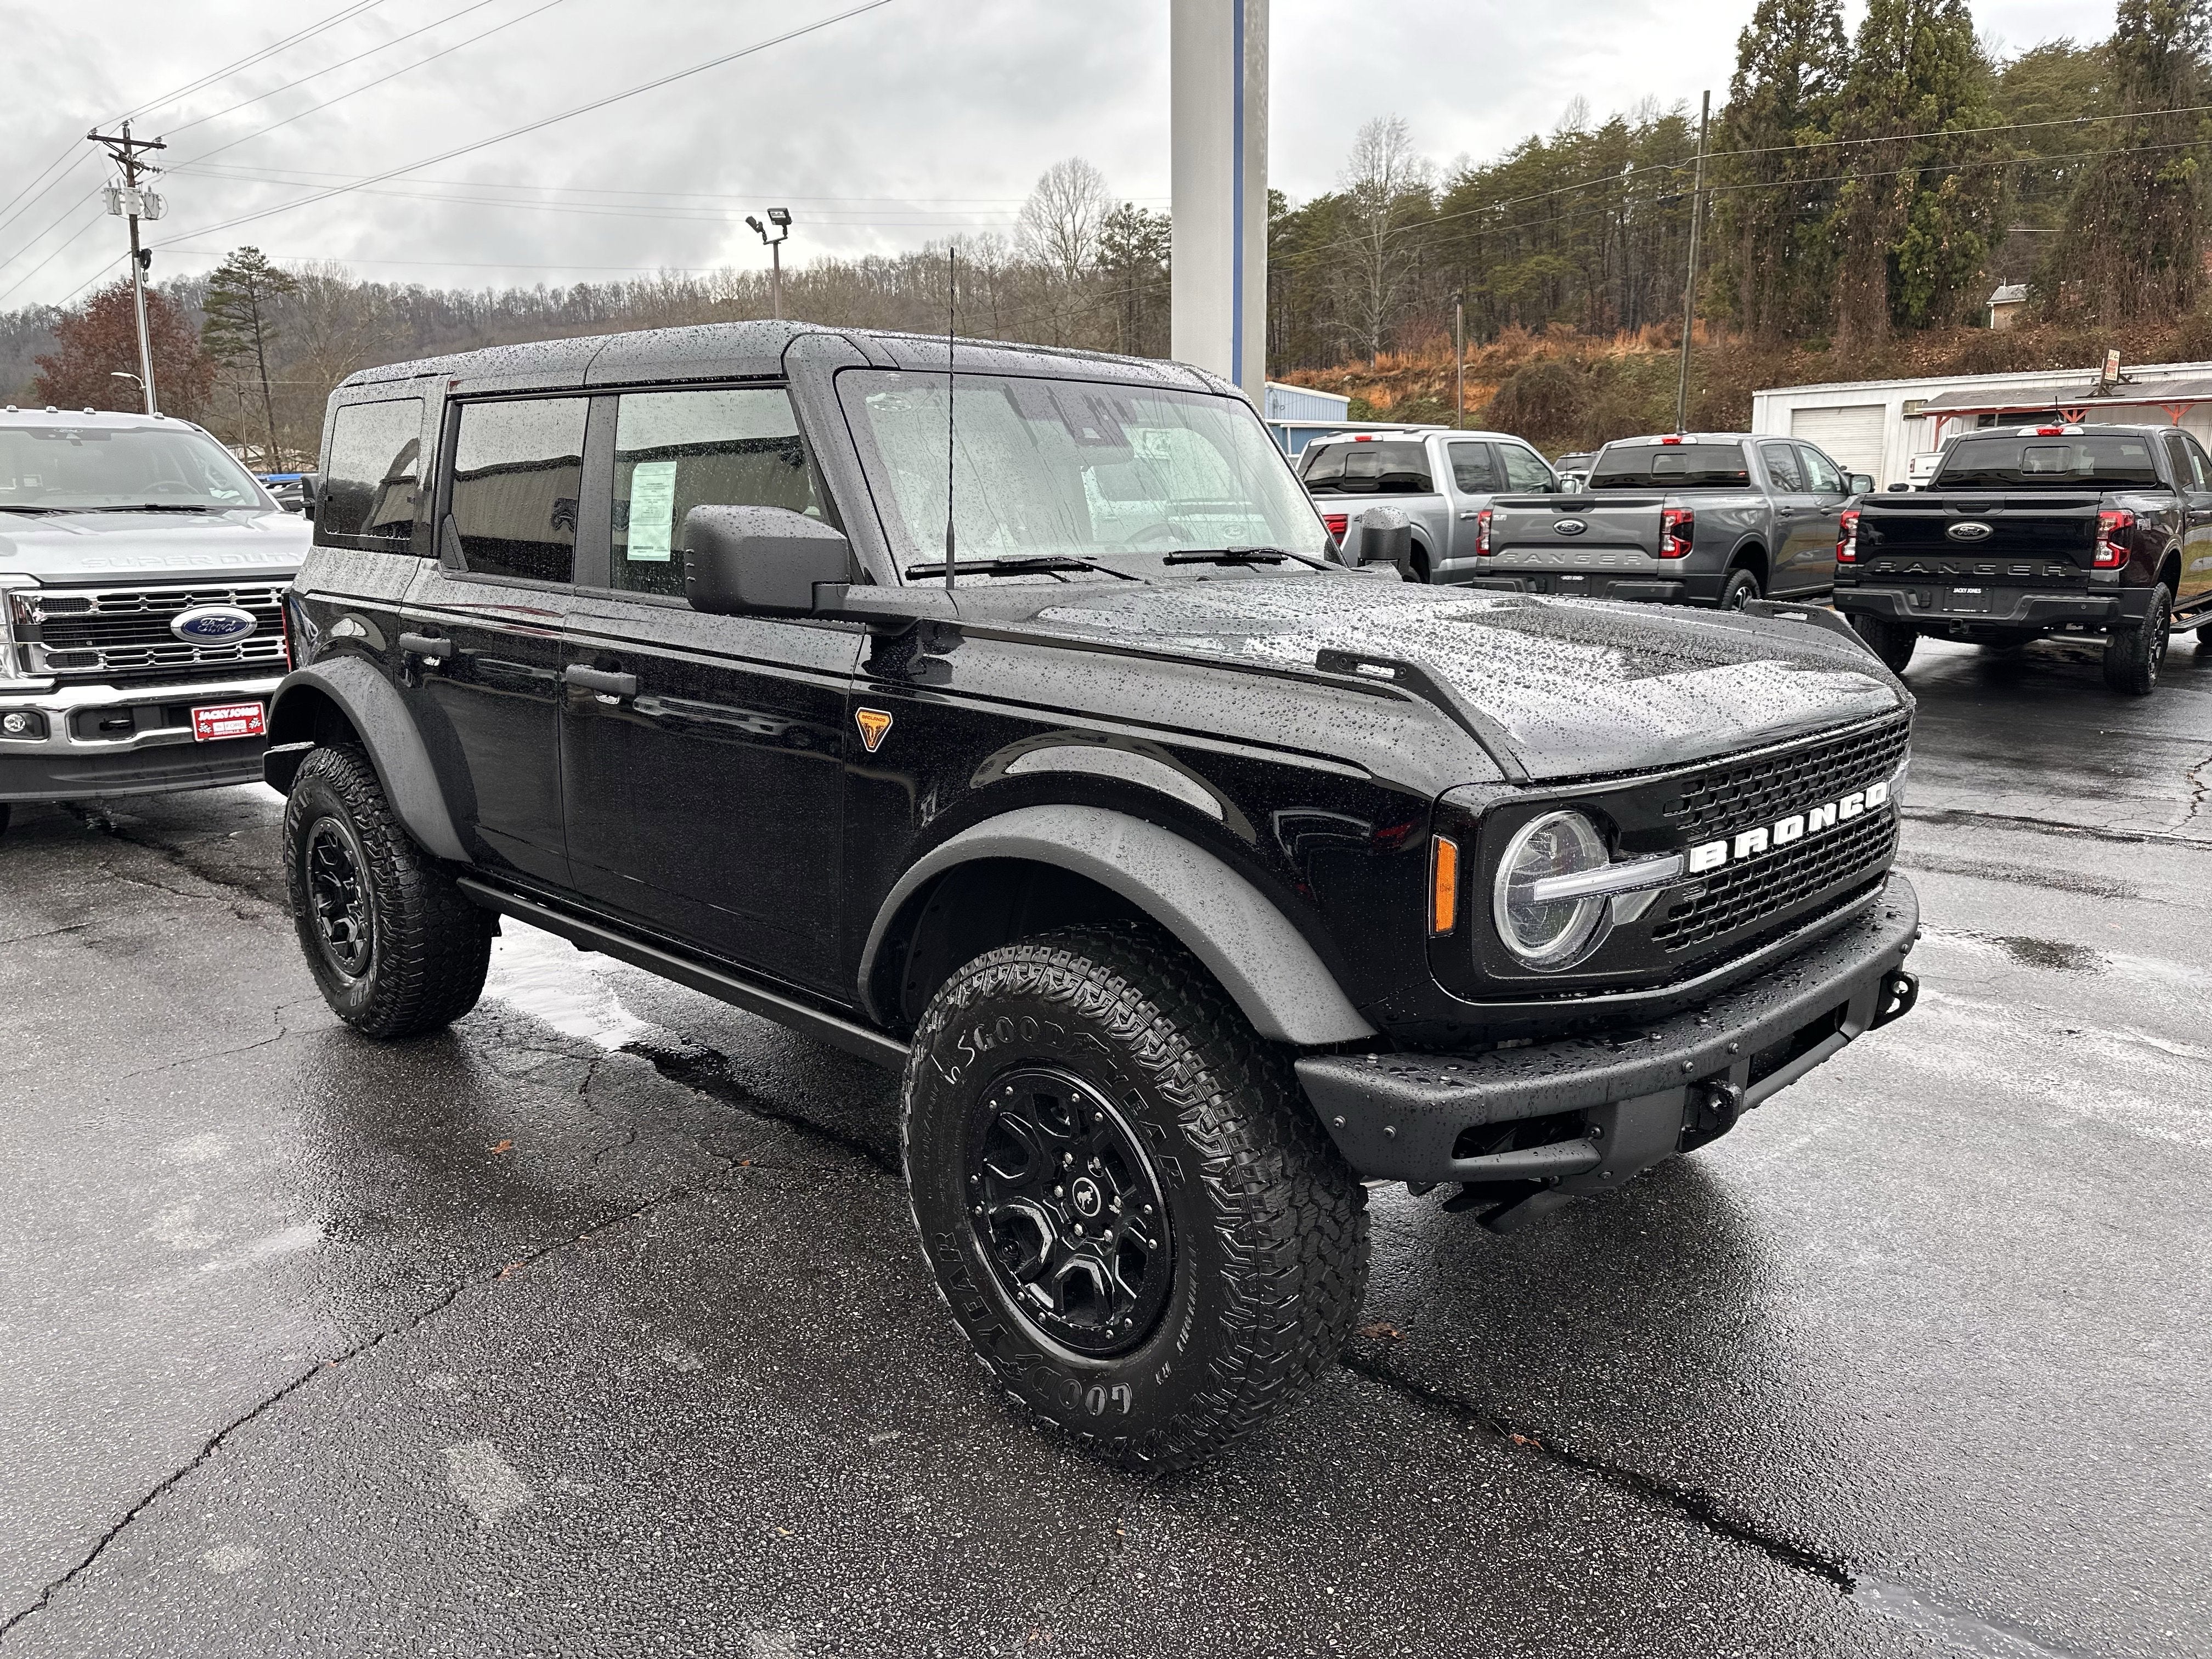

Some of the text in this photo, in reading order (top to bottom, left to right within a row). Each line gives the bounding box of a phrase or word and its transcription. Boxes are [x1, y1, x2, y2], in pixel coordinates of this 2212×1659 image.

[1957, 526, 1980, 535] Ford
[81, 554, 214, 568] SUPER
[1503, 553, 1642, 565] RANGER
[1875, 561, 2067, 576] RANGER
[198, 617, 236, 633] Ford
[198, 706, 259, 721] JACKY JONES
[1689, 781, 1887, 873] BRONCO
[974, 1015, 1187, 1190] GOODYEAR
[934, 1232, 1133, 1417] GOODYEAR
